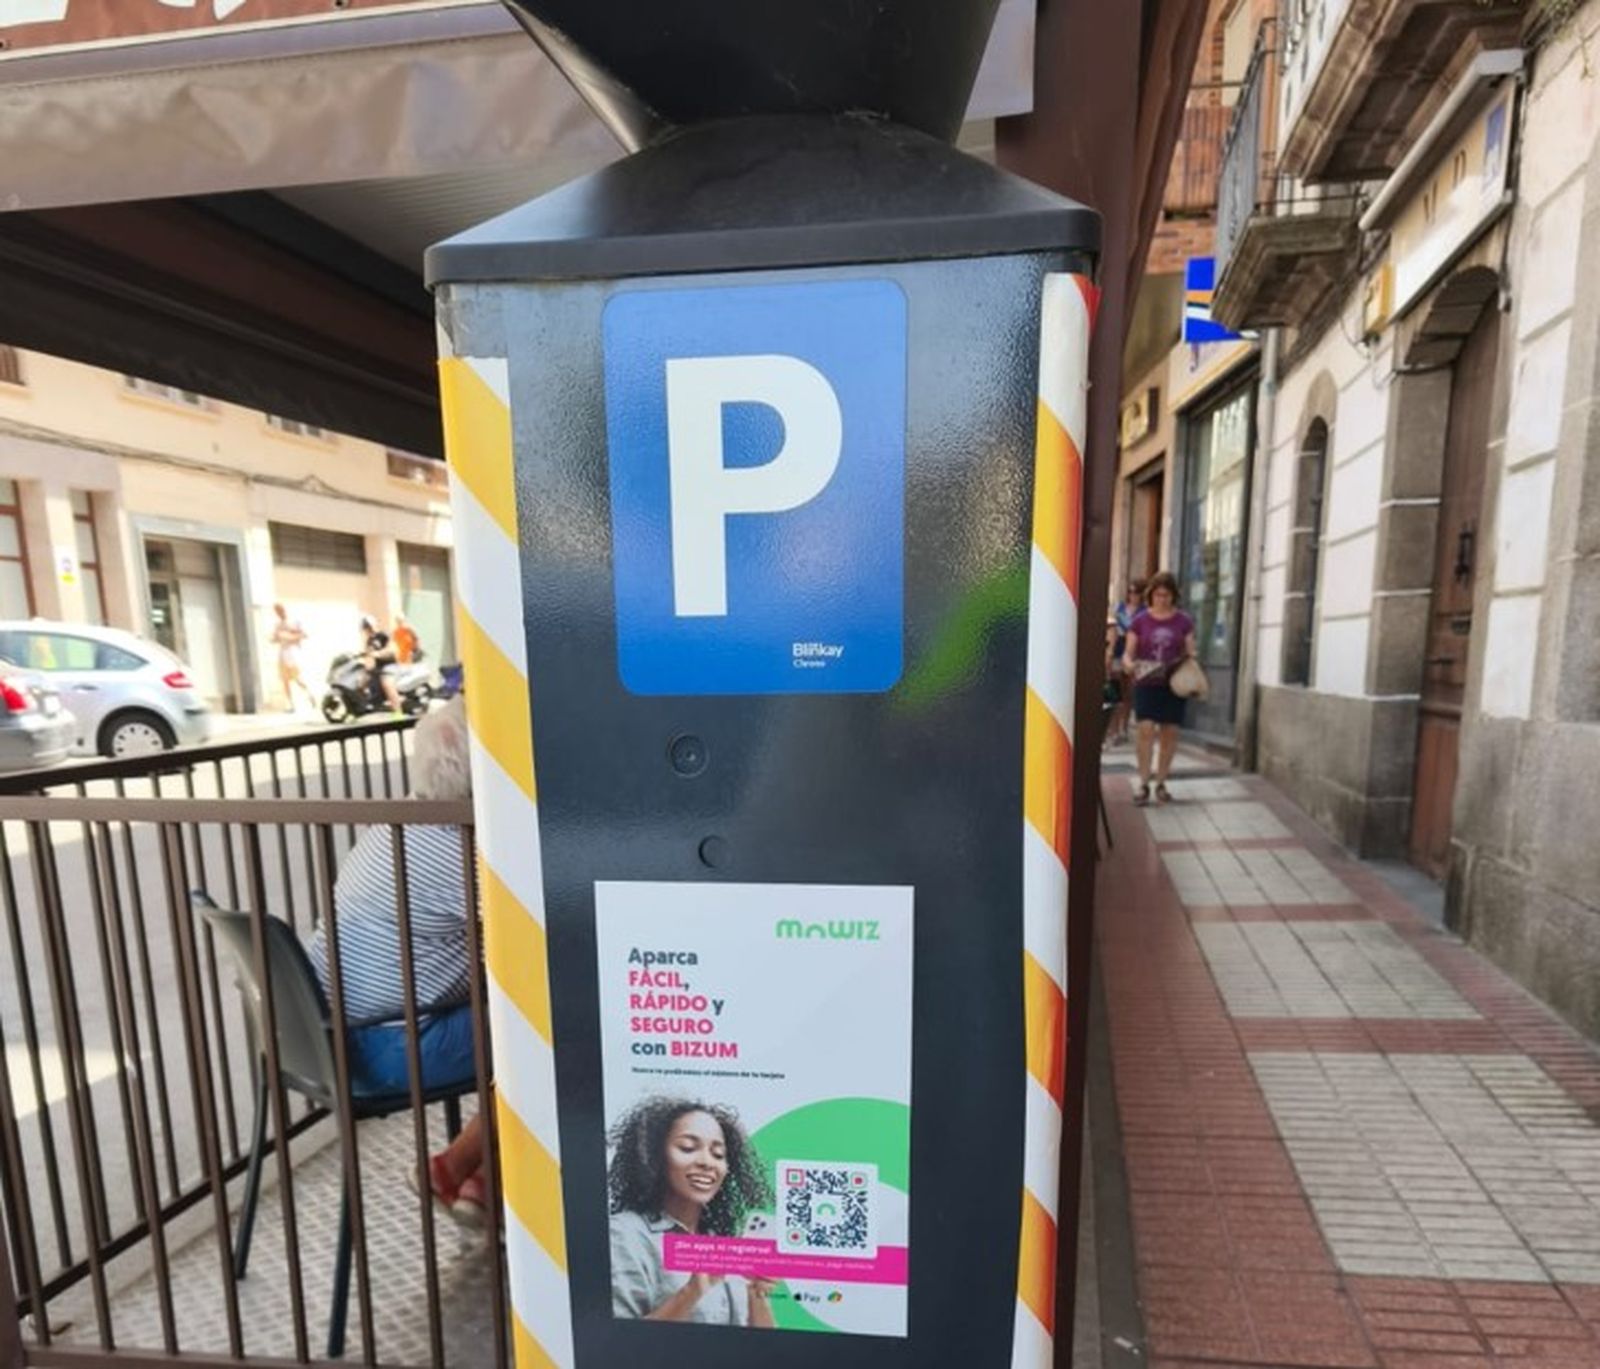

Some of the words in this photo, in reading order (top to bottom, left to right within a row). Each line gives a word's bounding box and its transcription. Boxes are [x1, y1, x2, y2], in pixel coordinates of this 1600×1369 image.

[665, 354, 843, 617] P
[628, 948, 698, 967] Aparca
[629, 968, 689, 991] FÁCIL,
[630, 992, 707, 1011] RÁPIDO
[712, 998, 724, 1016] y
[631, 1017, 714, 1034] SEGURO
[631, 1041, 667, 1055] con
[671, 1041, 738, 1057] BIZUM
